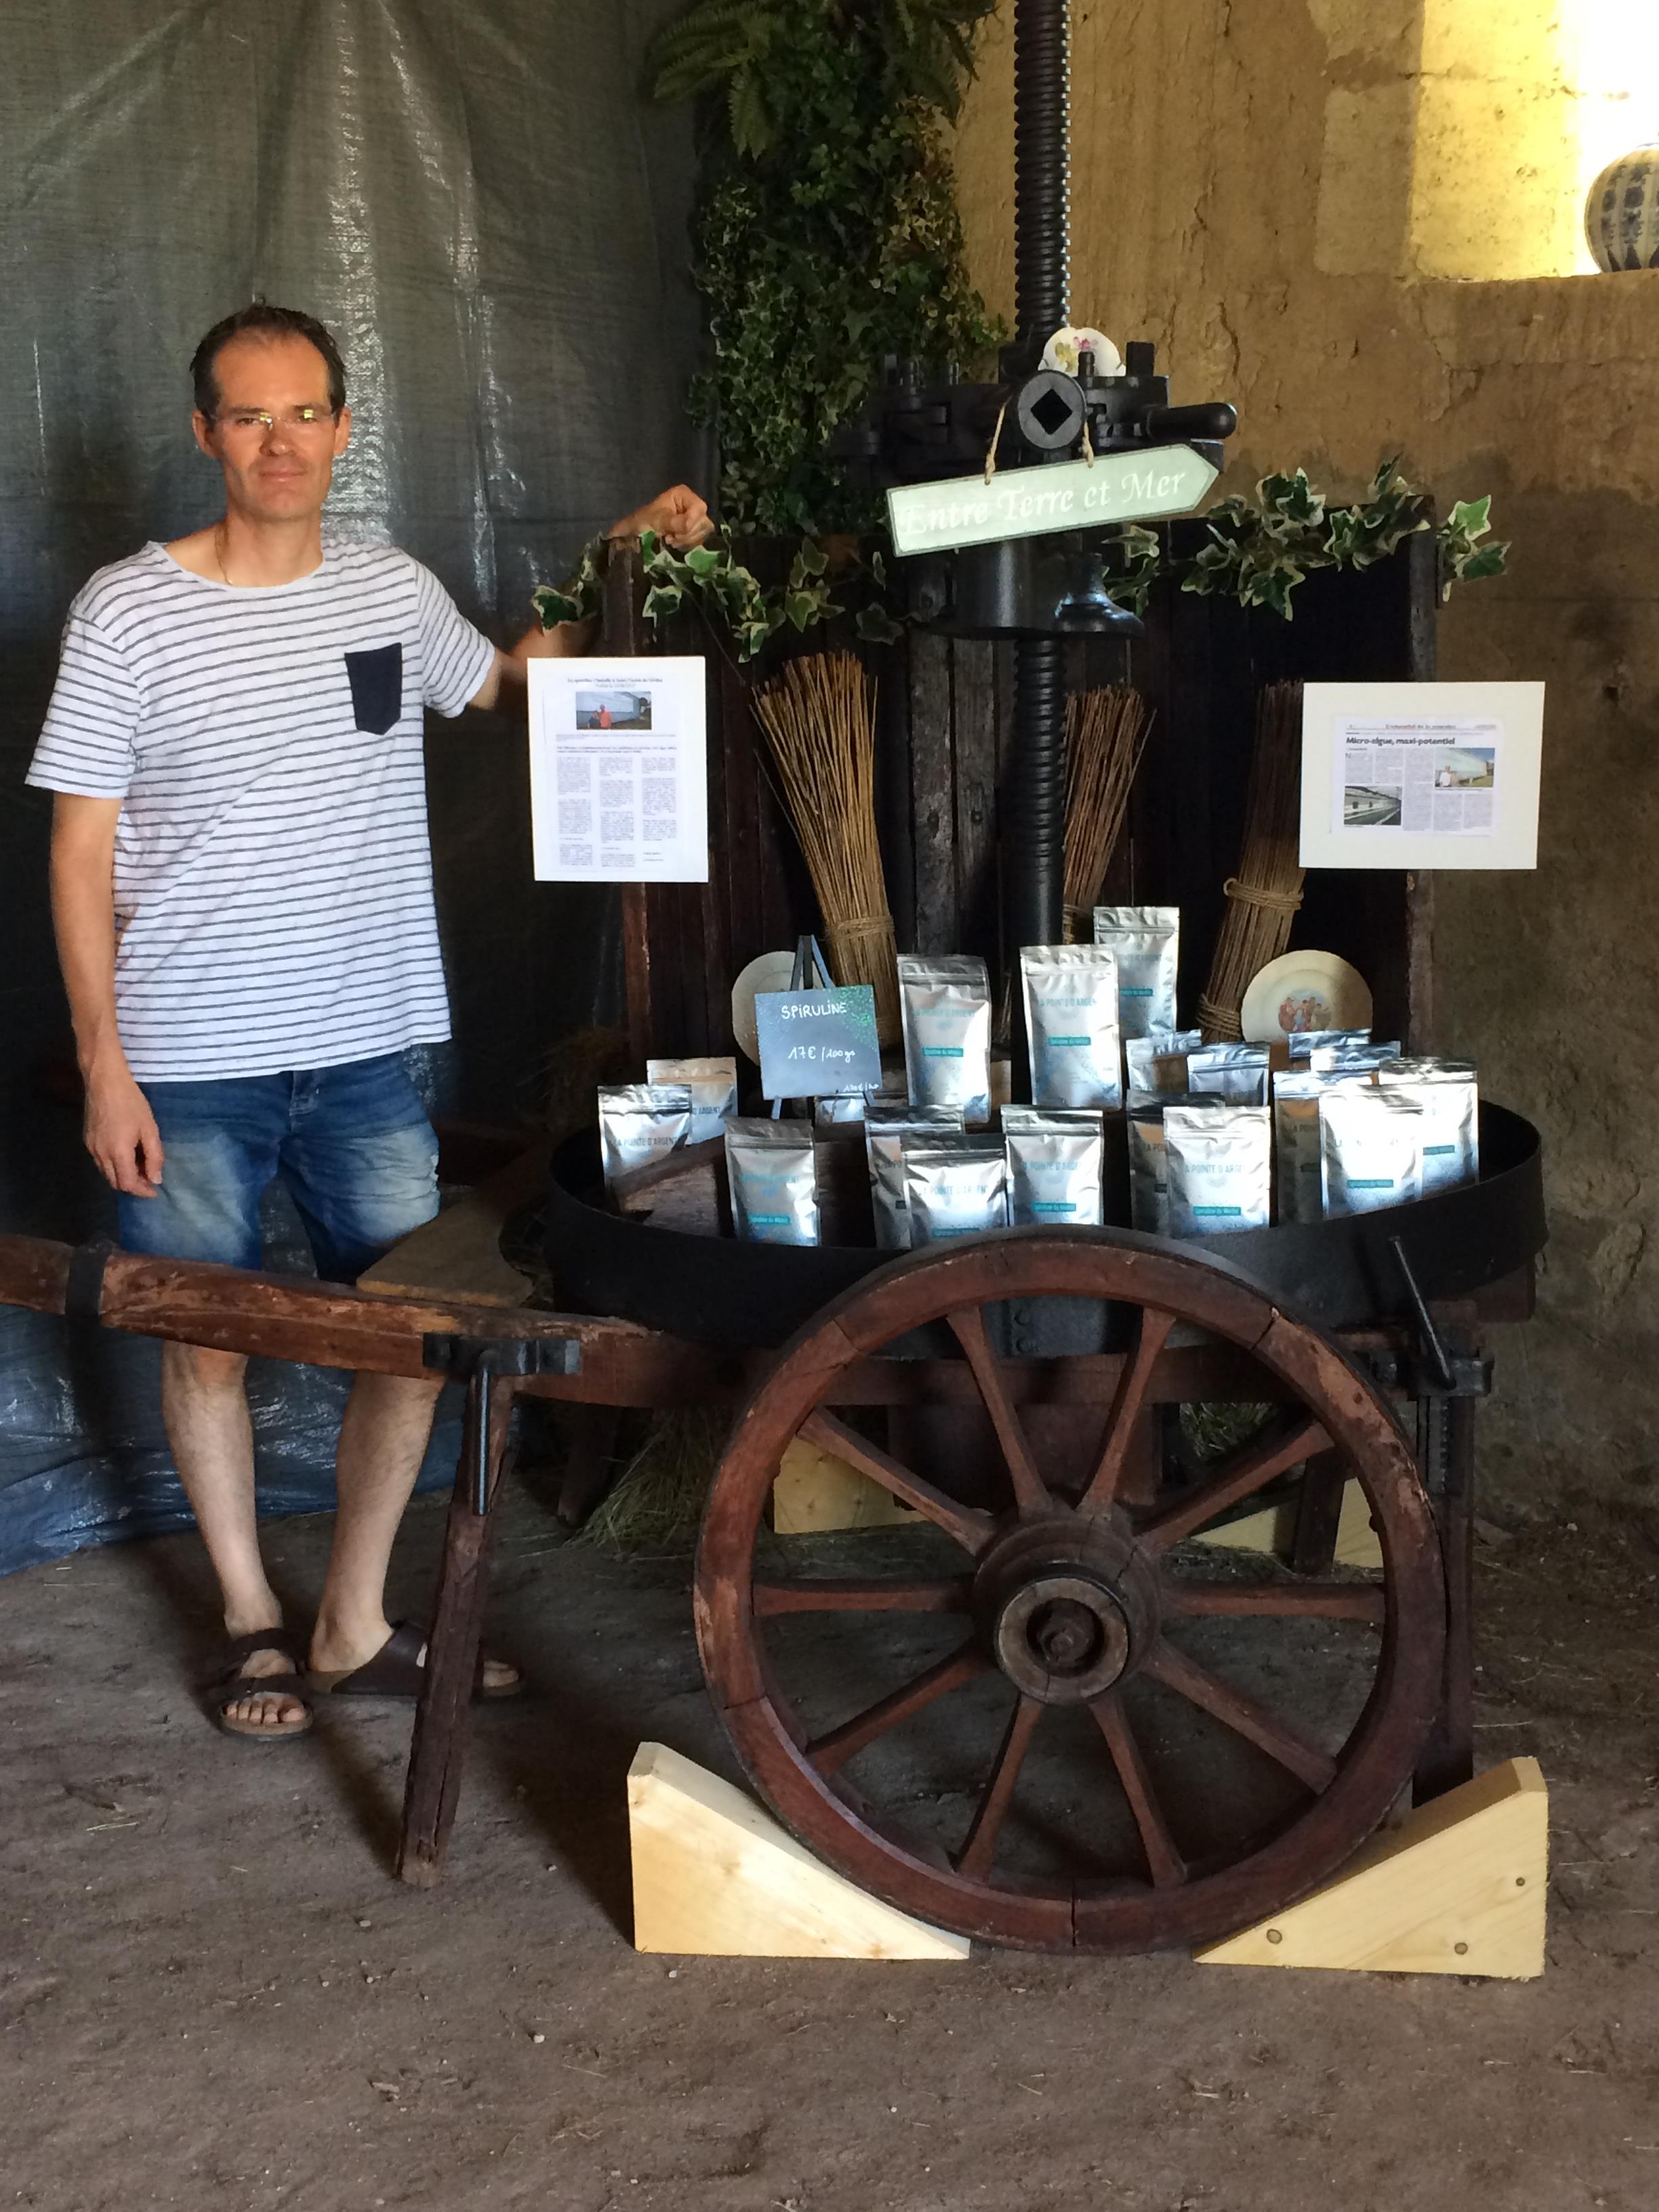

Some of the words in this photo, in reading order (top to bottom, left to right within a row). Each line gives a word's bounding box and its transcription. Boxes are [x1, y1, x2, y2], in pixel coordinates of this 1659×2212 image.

[903, 503, 988, 535] Entre
[997, 485, 1073, 521] Terre
[1084, 480, 1111, 508] et
[1120, 471, 1187, 504] Mer
[1346, 737, 1395, 746] Micro-algue,
[1396, 737, 1456, 746] maxi-potentiel
[788, 1046, 817, 1060] 17€
